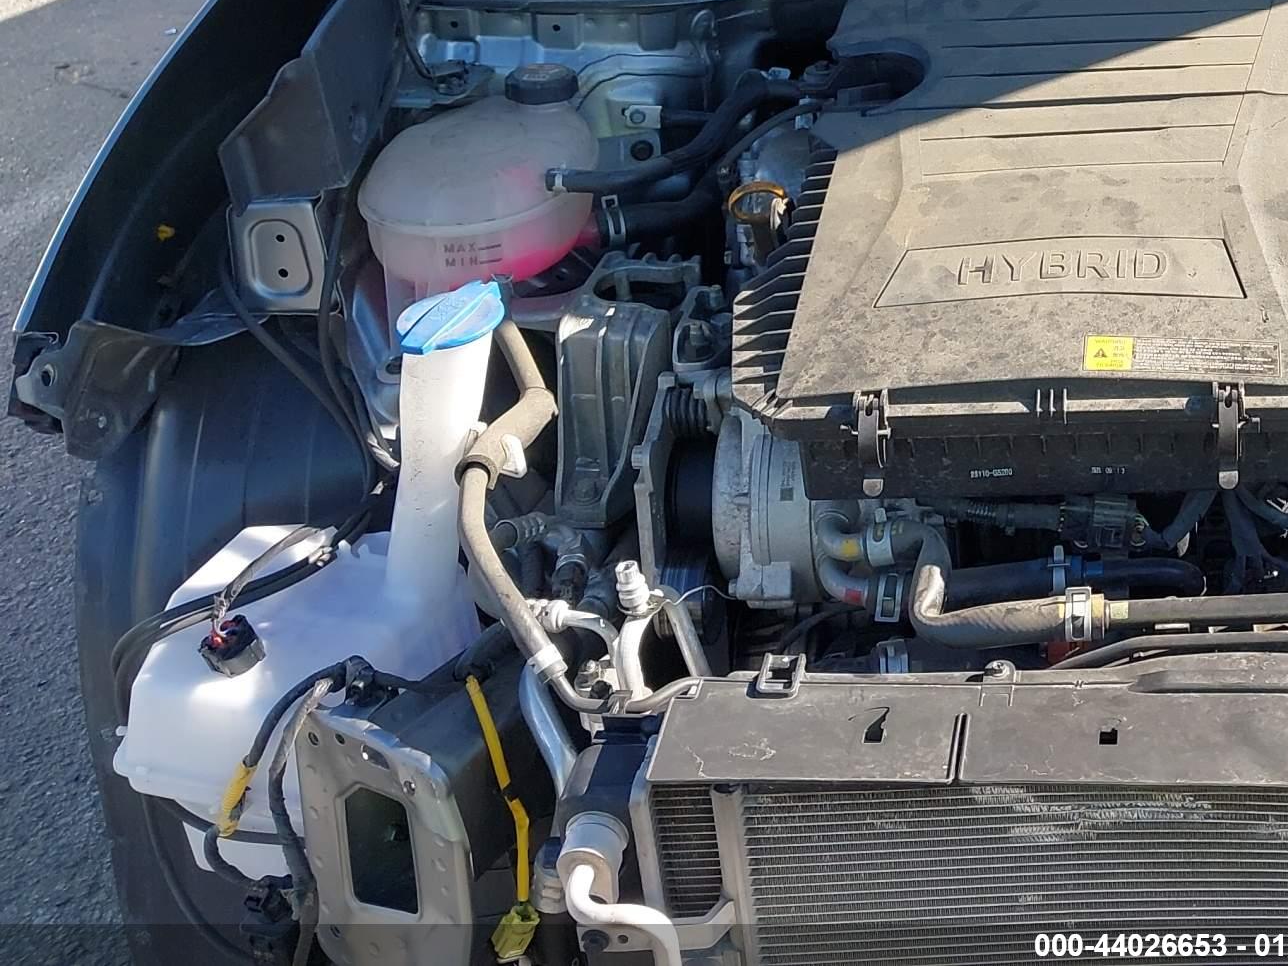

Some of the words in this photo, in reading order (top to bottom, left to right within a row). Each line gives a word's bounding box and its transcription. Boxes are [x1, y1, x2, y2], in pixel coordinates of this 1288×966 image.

[443, 242, 476, 253] MAX
[445, 256, 478, 267] MIN
[957, 249, 1168, 285] HYBRID
